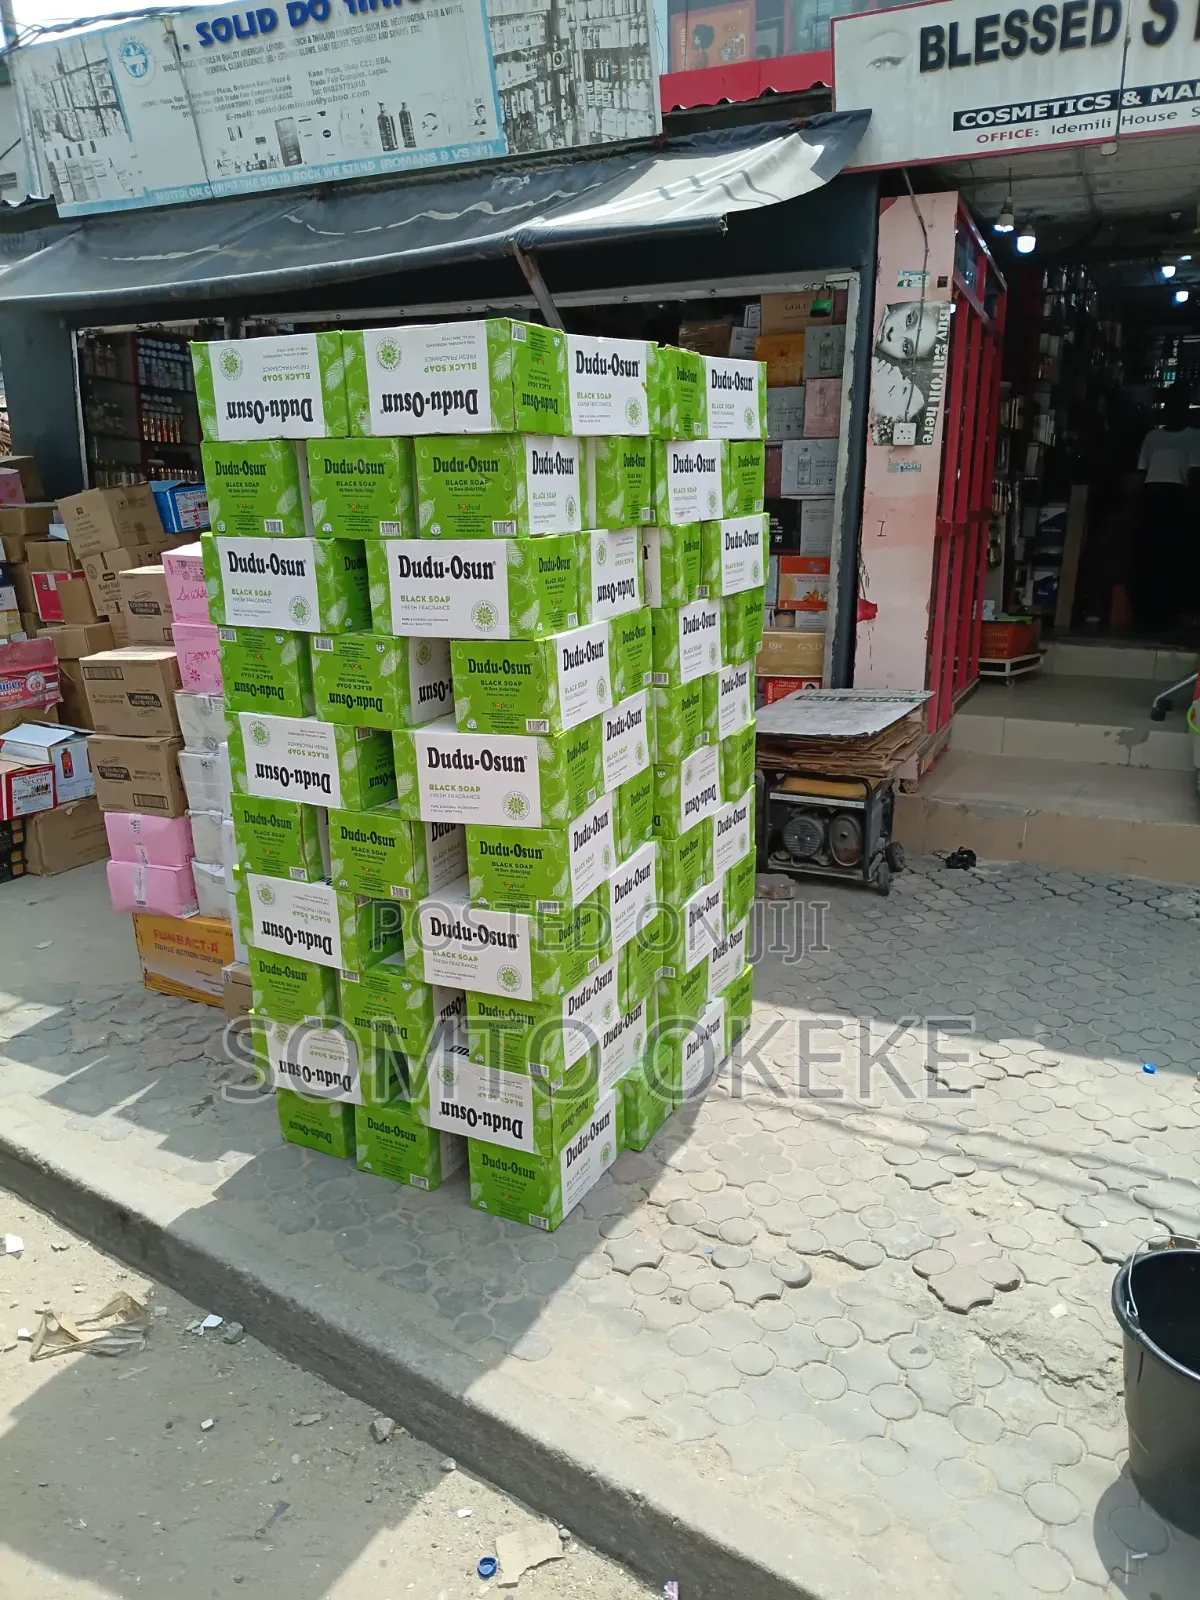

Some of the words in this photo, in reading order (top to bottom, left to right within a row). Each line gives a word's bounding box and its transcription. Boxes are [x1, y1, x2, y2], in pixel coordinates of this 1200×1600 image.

[195, 7, 279, 47] SOLID
[312, 28, 336, 44] THAILAND
[427, 9, 440, 20] FAIR
[378, 32, 389, 41] AND
[919, 0, 1123, 73] BLESSED
[959, 94, 1112, 128] COSMETICS
[1122, 91, 1142, 107] &
[976, 127, 1040, 146] OFFICE:
[1051, 118, 1113, 136] Idemili
[1121, 110, 1178, 127] House
[259, 172, 290, 186] SOLID
[292, 167, 322, 182] ROCK
[323, 166, 340, 177] WE
[342, 162, 376, 176] STAND
[380, 152, 438, 170] (ROMANS
[440, 150, 450, 161] 8
[576, 351, 639, 377] Dudu-Osun
[712, 369, 752, 391] Dudu-Osun
[227, 399, 313, 424] Dudu-Osun
[382, 389, 478, 417] Dudu-Osun
[522, 393, 558, 414] Dudu-Osun
[922, 406, 939, 444] here
[215, 461, 266, 475] Dudu-Osun
[325, 458, 385, 474] Dudu-Osun
[433, 456, 498, 472] Dudu-Osun
[533, 451, 574, 474] Dudu-Osun
[673, 454, 715, 473] Dudu-Osun
[725, 530, 759, 551] Dudu-Osun
[228, 551, 305, 577] Dudu-Osun
[398, 555, 494, 580] Dudu-Osun
[539, 556, 571, 573] Dudu-Osun
[597, 578, 634, 603] Dudu-Osun
[683, 612, 716, 635] Dudu-Osun
[468, 659, 531, 675] Dudu-Osun
[563, 641, 604, 671] Dudu-Osun
[234, 682, 284, 700] Dudu-Osun
[328, 692, 383, 712] Dudu-Osun
[606, 708, 642, 741] Dudu-Osun
[427, 747, 525, 772] Dudu-Osun
[256, 763, 331, 793] Dudu-Osun
[685, 784, 716, 815] Dudu-Osun
[244, 811, 292, 830] Dudu-Osun
[573, 809, 609, 852] Dudu-Osun
[717, 805, 746, 836] Dudu-Osun
[340, 826, 395, 847] Dudu-Osun
[480, 841, 542, 859] Dudu-Osun
[614, 861, 651, 904] Dudu-Osun
[262, 921, 332, 955] Dudu-Osun
[430, 917, 518, 949] Dudu-Osun
[432, 950, 456, 959] BLACK
[458, 954, 478, 962] SOAP
[259, 961, 307, 981] Dudu-Osun
[568, 967, 613, 1016] Dudu-Osun
[478, 1002, 535, 1025] Dudu-Osun
[603, 1003, 642, 1050] Dudu-Osun
[279, 1060, 352, 1092] Dudu-Osun
[368, 1117, 416, 1142] Dudu-Osun
[441, 1101, 523, 1139] Dudu-Osun
[566, 1110, 611, 1169] Dudu-Osun
[482, 1154, 536, 1180] Dudu-Osun
